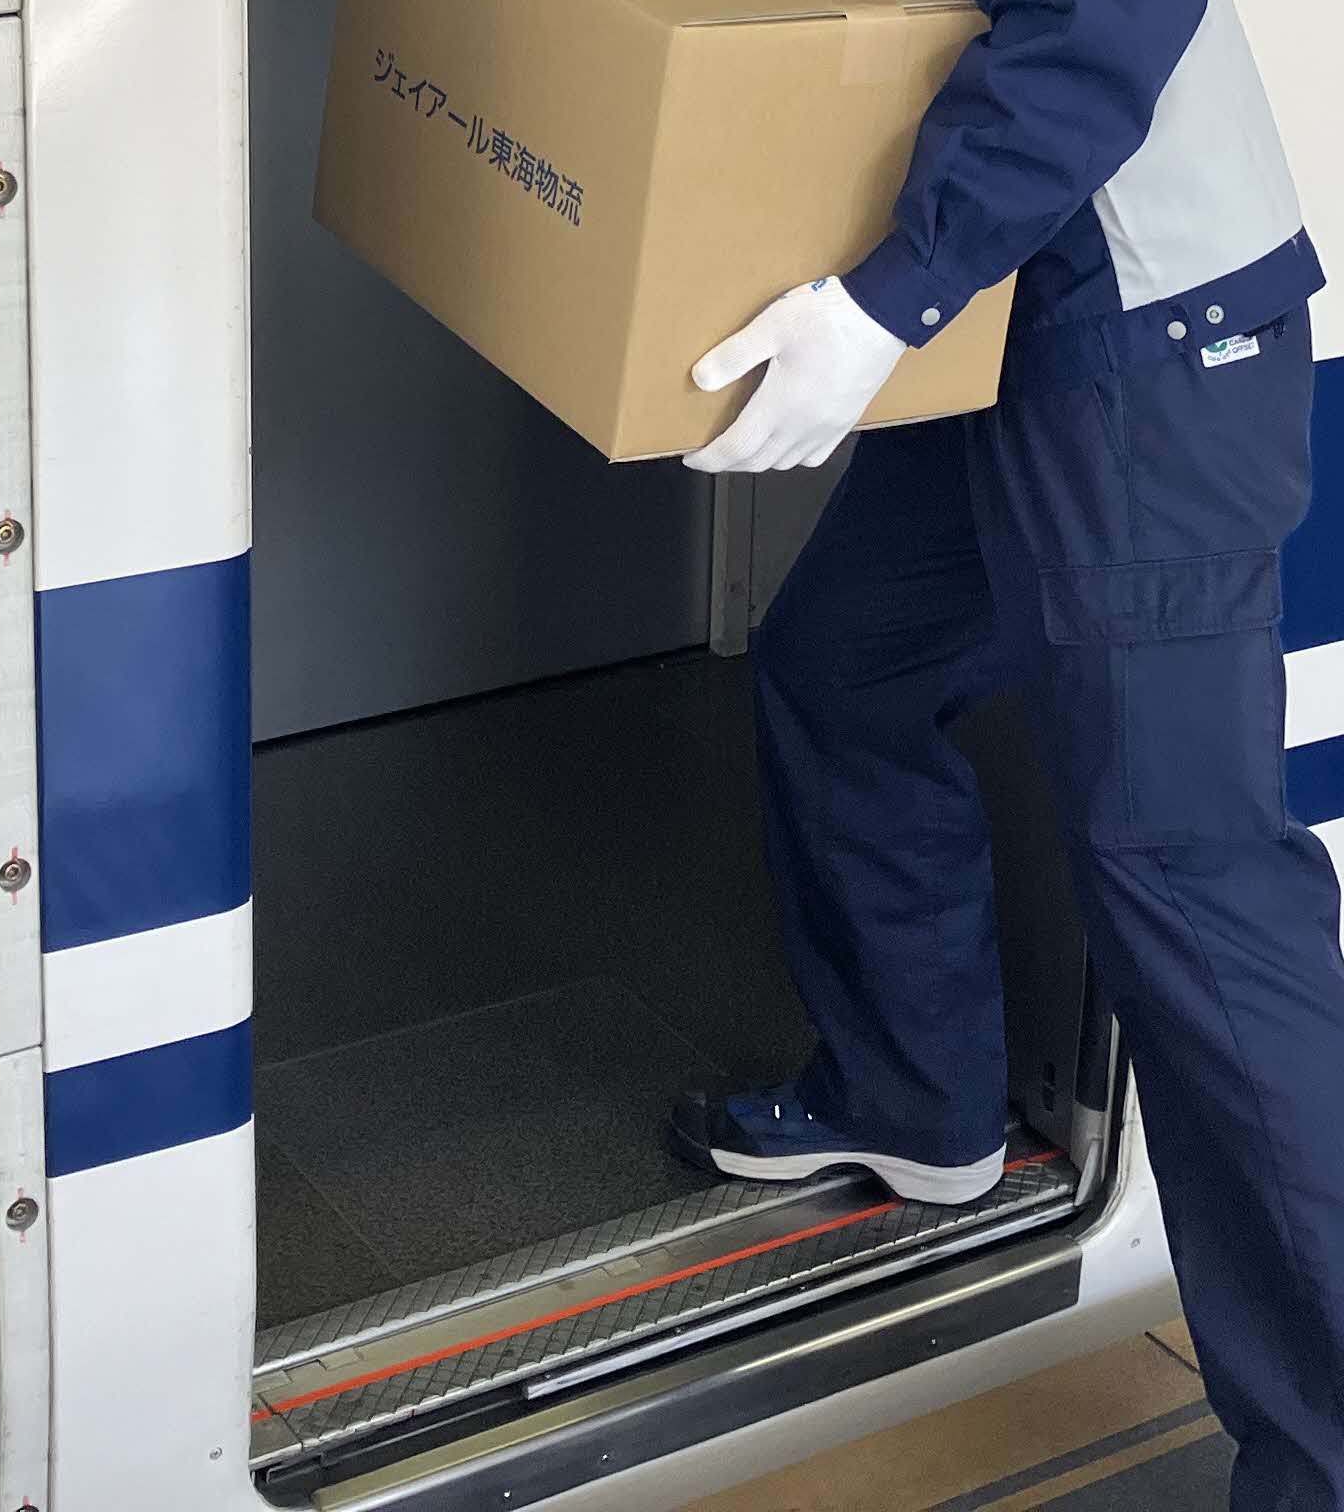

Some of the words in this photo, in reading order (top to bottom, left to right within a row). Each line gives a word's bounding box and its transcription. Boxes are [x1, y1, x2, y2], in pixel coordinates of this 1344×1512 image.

[373, 48, 584, 227] ジェイアール東海物流
